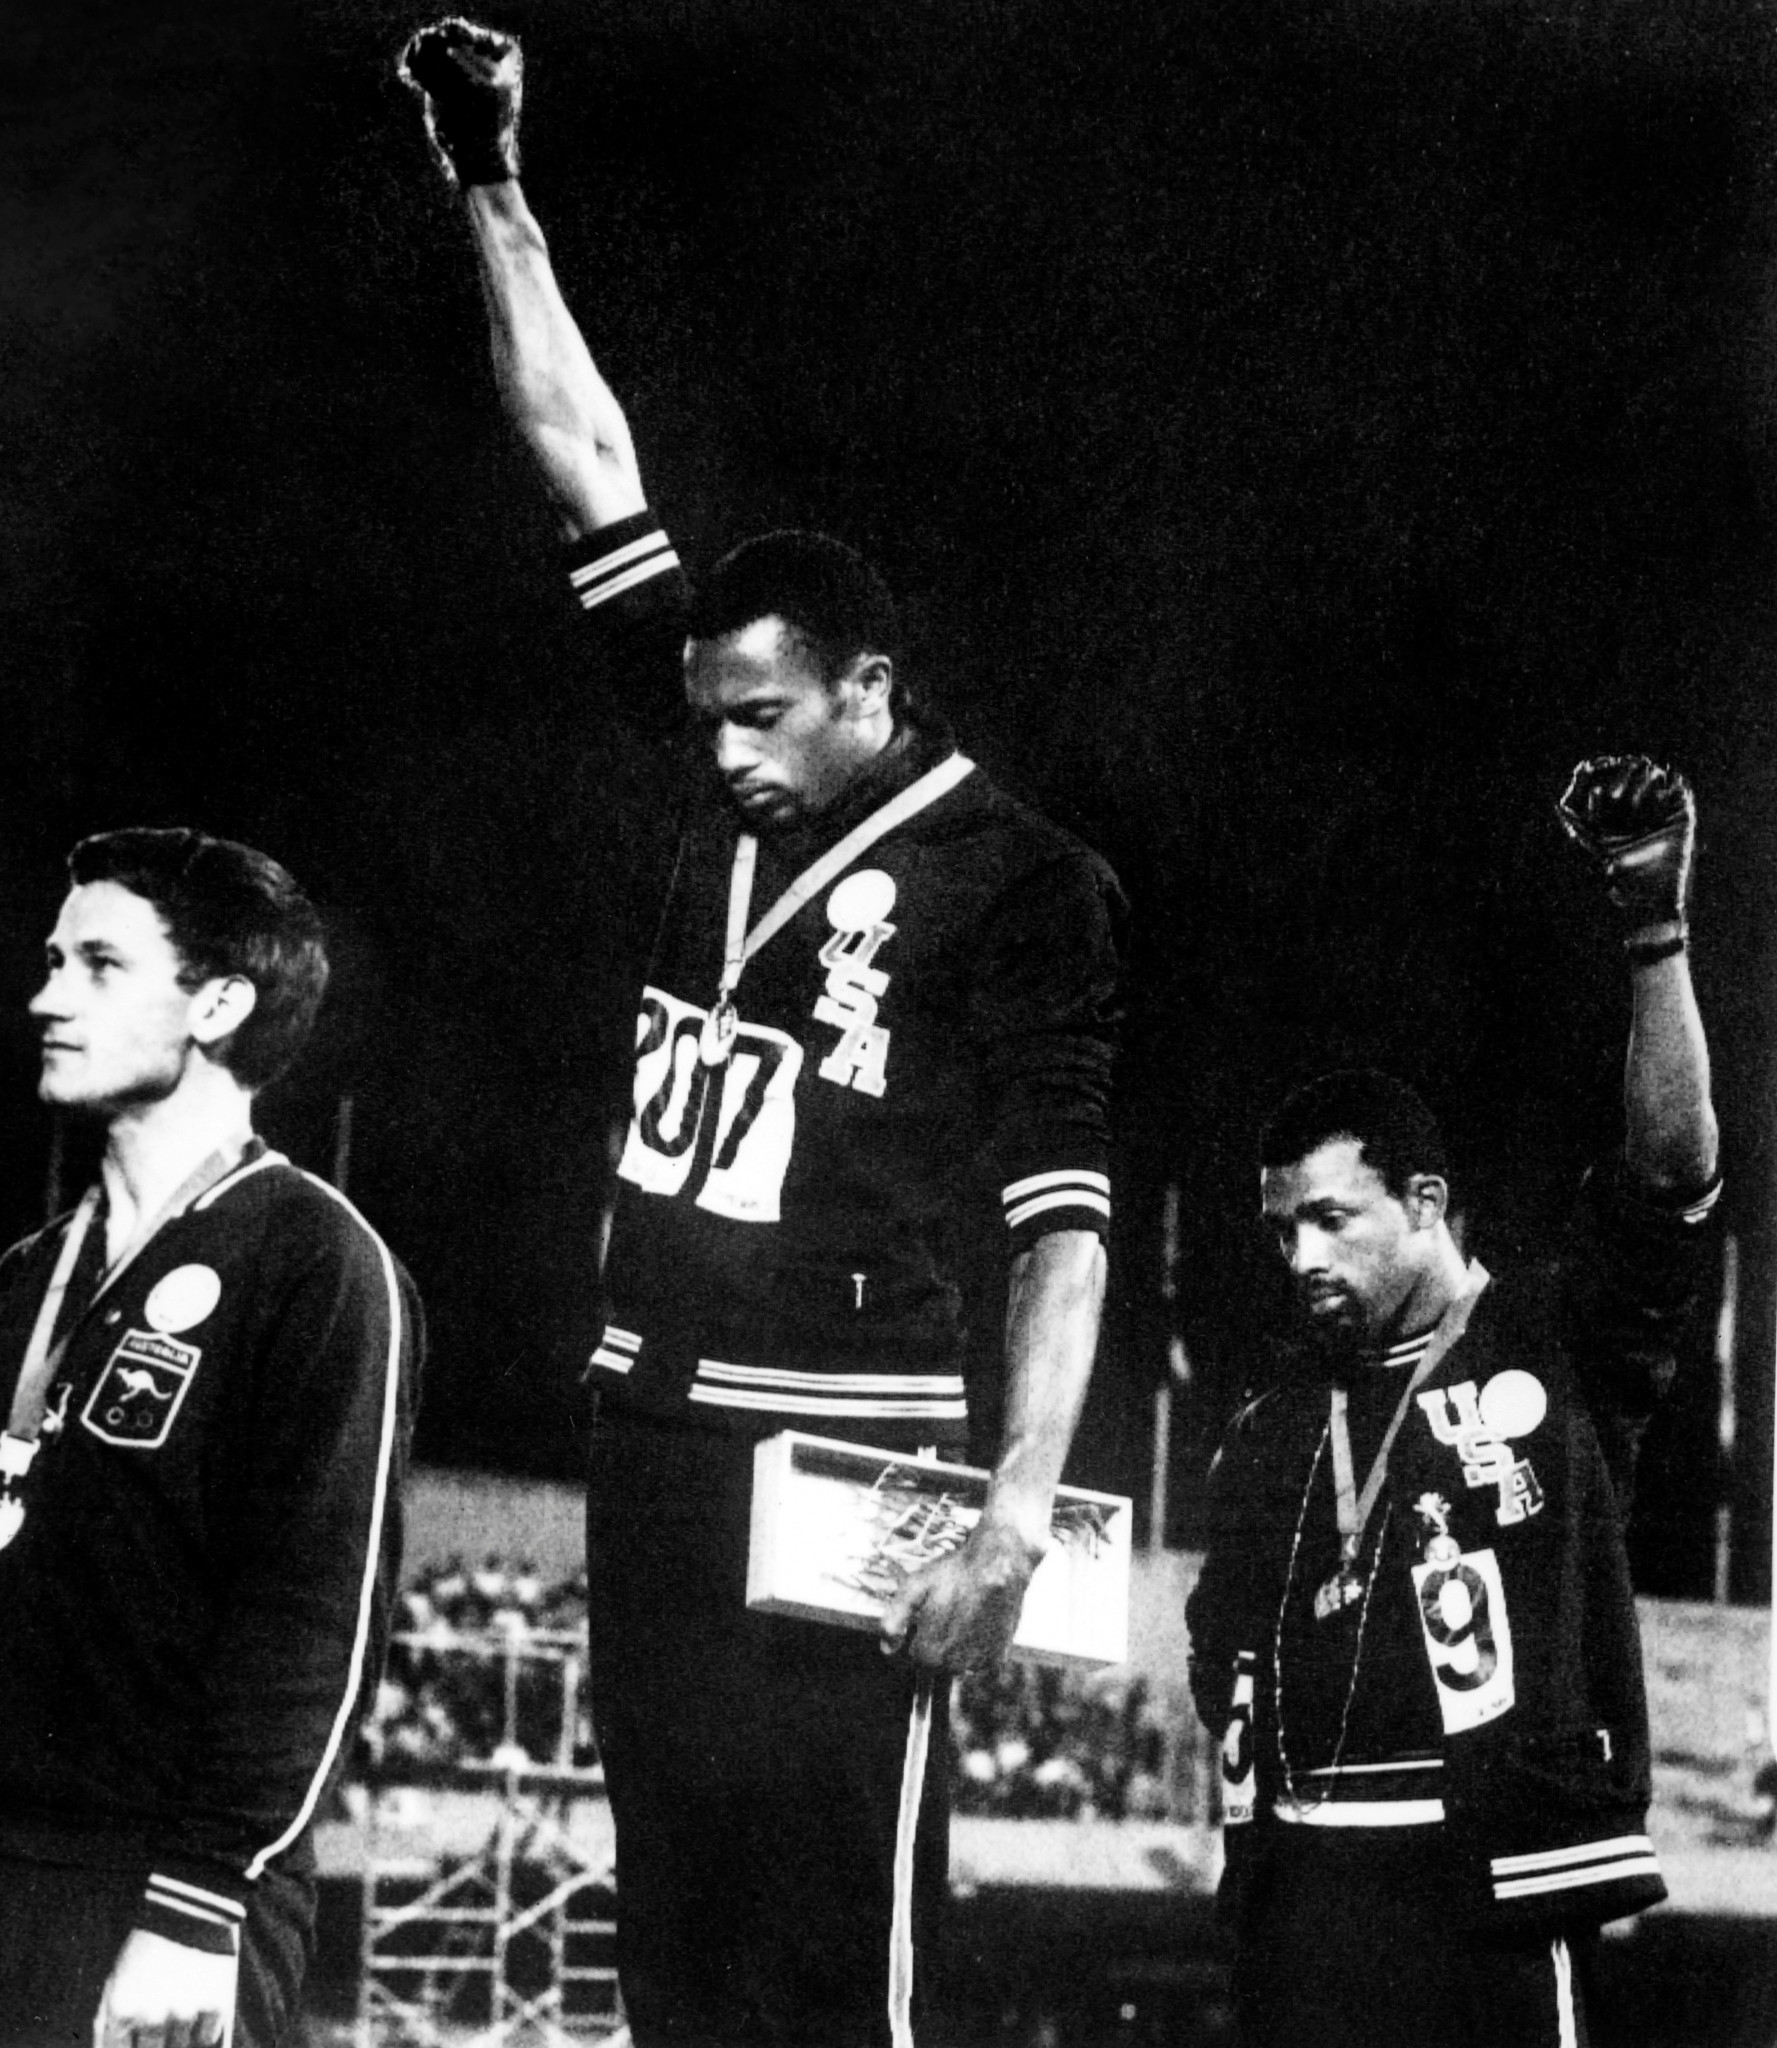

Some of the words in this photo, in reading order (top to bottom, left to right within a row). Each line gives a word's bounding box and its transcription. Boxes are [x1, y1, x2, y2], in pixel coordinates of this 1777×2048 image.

[812, 920, 897, 1098] USA
[126, 1337, 190, 1365] AUSTRALIA
[1416, 1380, 1544, 1526] USA
